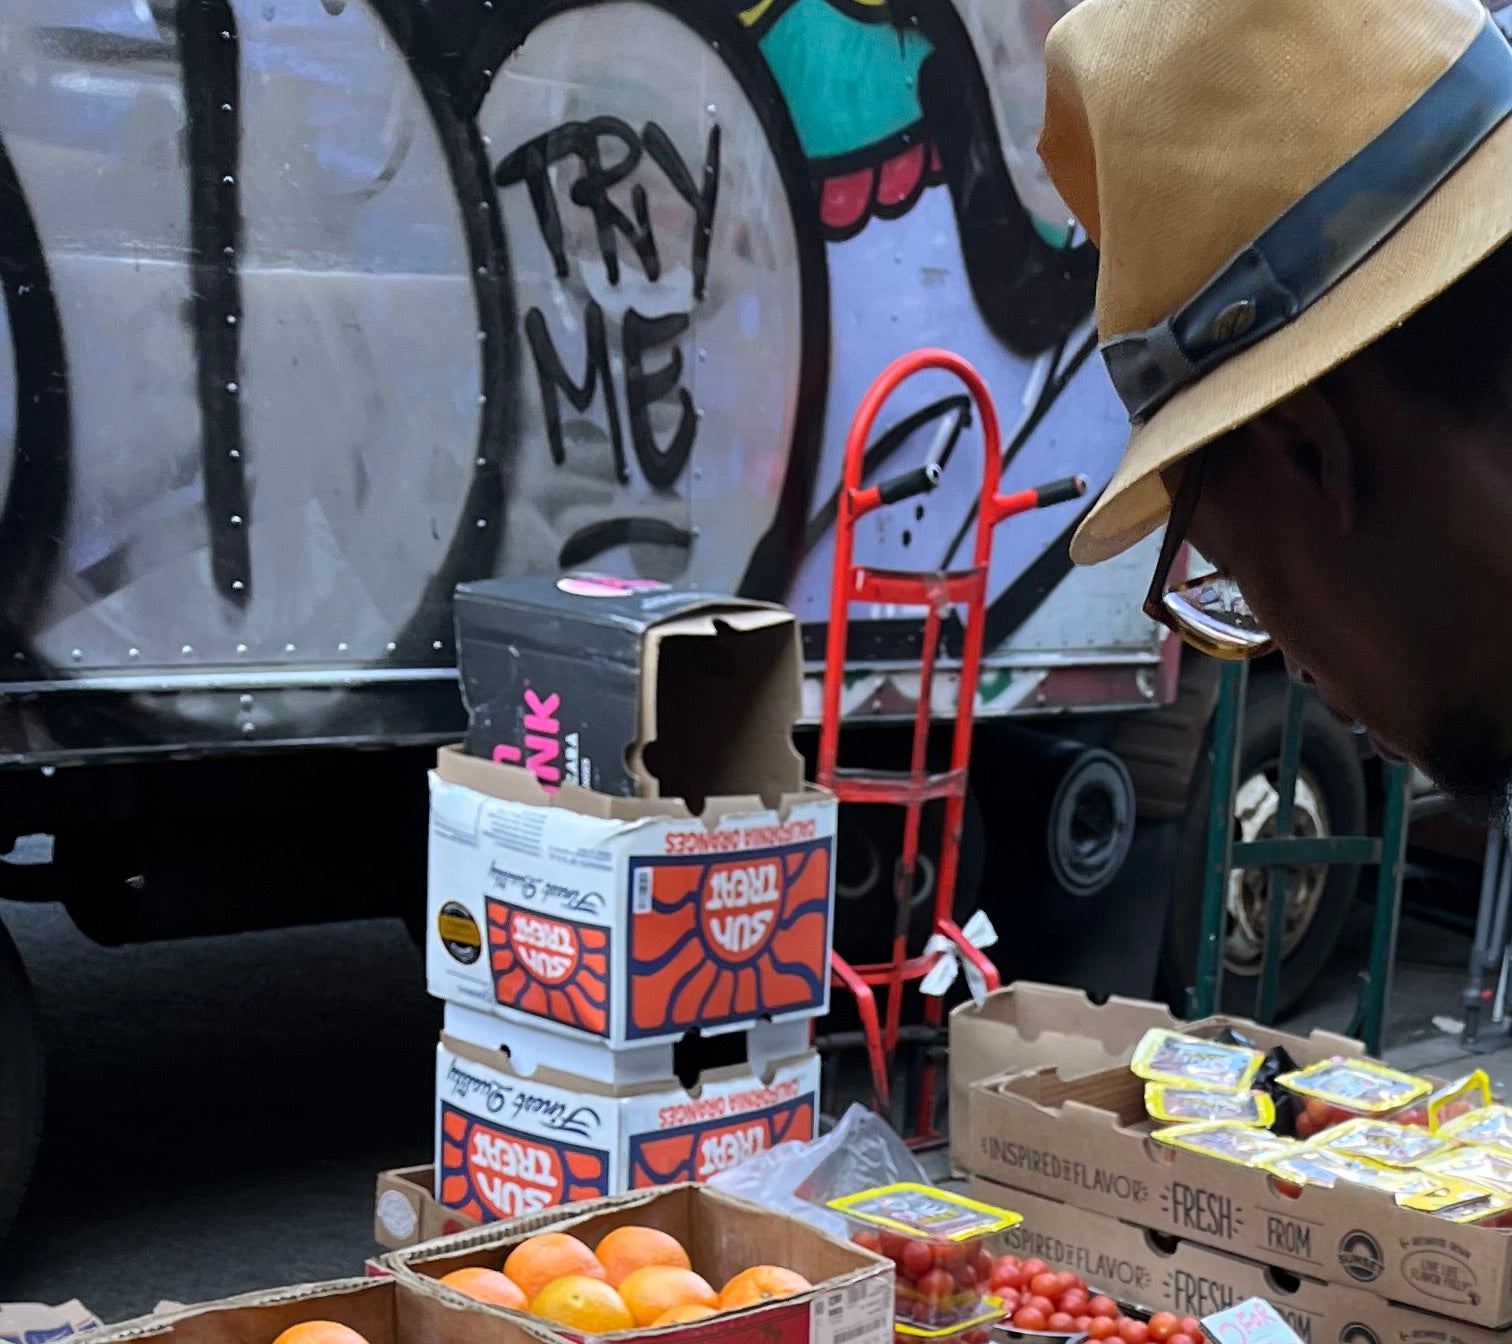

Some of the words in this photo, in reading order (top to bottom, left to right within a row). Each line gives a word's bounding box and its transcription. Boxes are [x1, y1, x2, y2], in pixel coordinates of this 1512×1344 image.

[525, 301, 697, 489] ME
[664, 828, 740, 855] ORANGES
[743, 819, 816, 848] CALIFORNIA
[704, 863, 780, 911] TREAT
[512, 914, 576, 957] TREAT
[708, 908, 774, 953] SUN
[518, 945, 572, 979] SUN
[447, 1058, 513, 1113] Quality
[512, 1091, 600, 1140] Finest
[658, 1096, 726, 1129] ORANGES
[470, 1131, 559, 1187] TREAT
[989, 1136, 1062, 1179] INSPIRED
[1073, 1162, 1141, 1204] FLAVOR
[477, 1173, 552, 1217] SUN
[1172, 1181, 1234, 1239] FRESH
[1003, 1227, 1065, 1268] NSPIRED
[1076, 1247, 1144, 1290] FLAVOR
[1267, 1217, 1312, 1258] FROM
